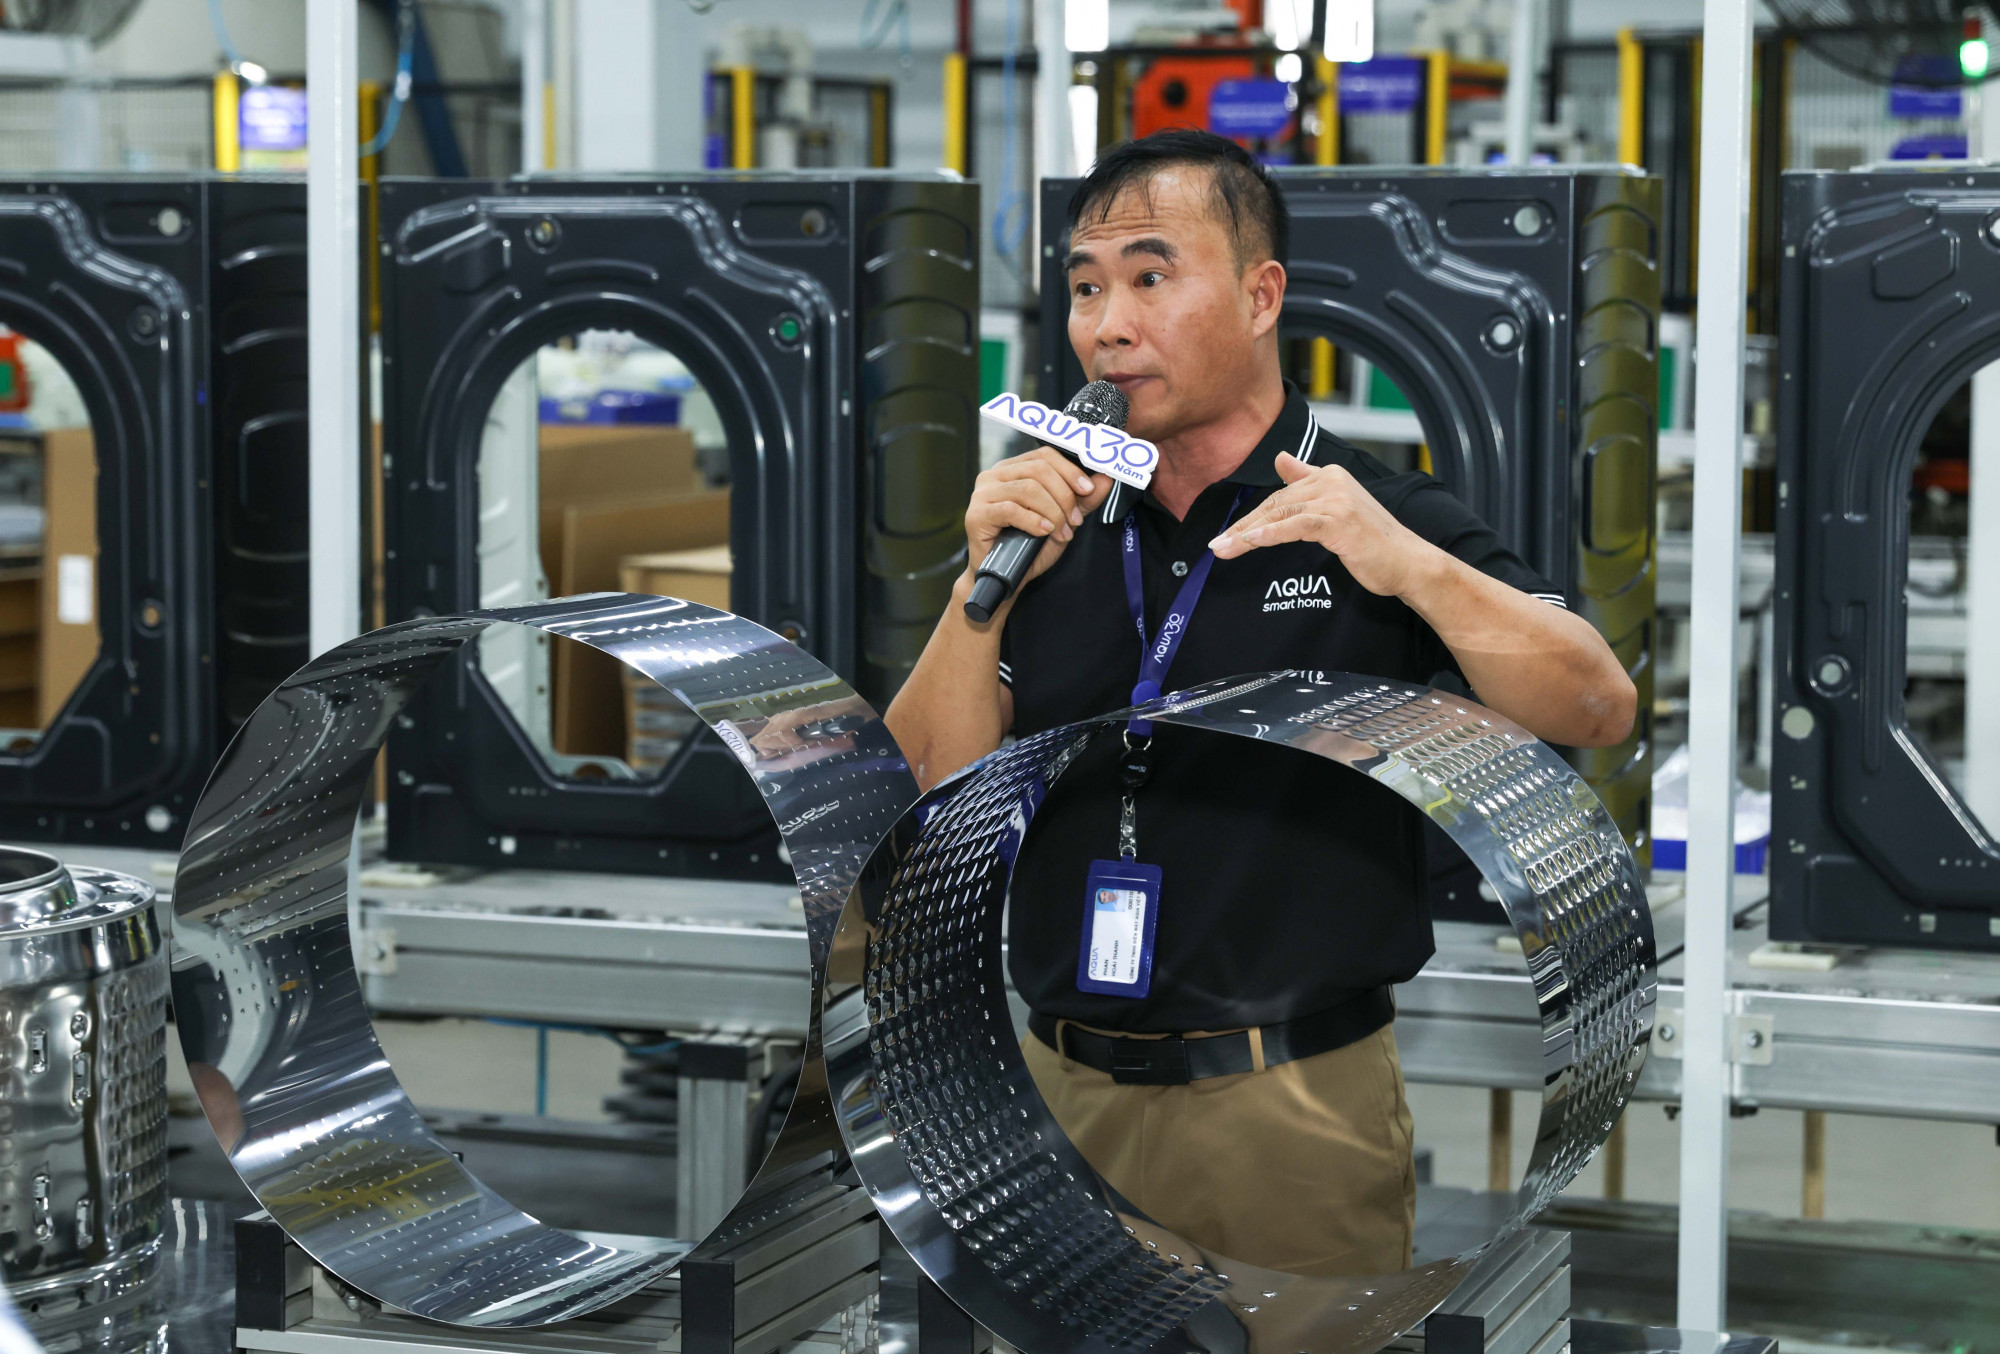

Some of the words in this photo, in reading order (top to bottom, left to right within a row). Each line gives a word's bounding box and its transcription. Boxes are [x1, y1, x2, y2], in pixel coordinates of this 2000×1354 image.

[988, 396, 1153, 467] AQUA30
[1114, 463, 1143, 480] Năm
[1264, 574, 1332, 598] AQUA
[1262, 597, 1295, 612] smart
[1297, 596, 1332, 608] home
[1154, 613, 1181, 663] AQUA30
[1089, 947, 1099, 975] AQUA
